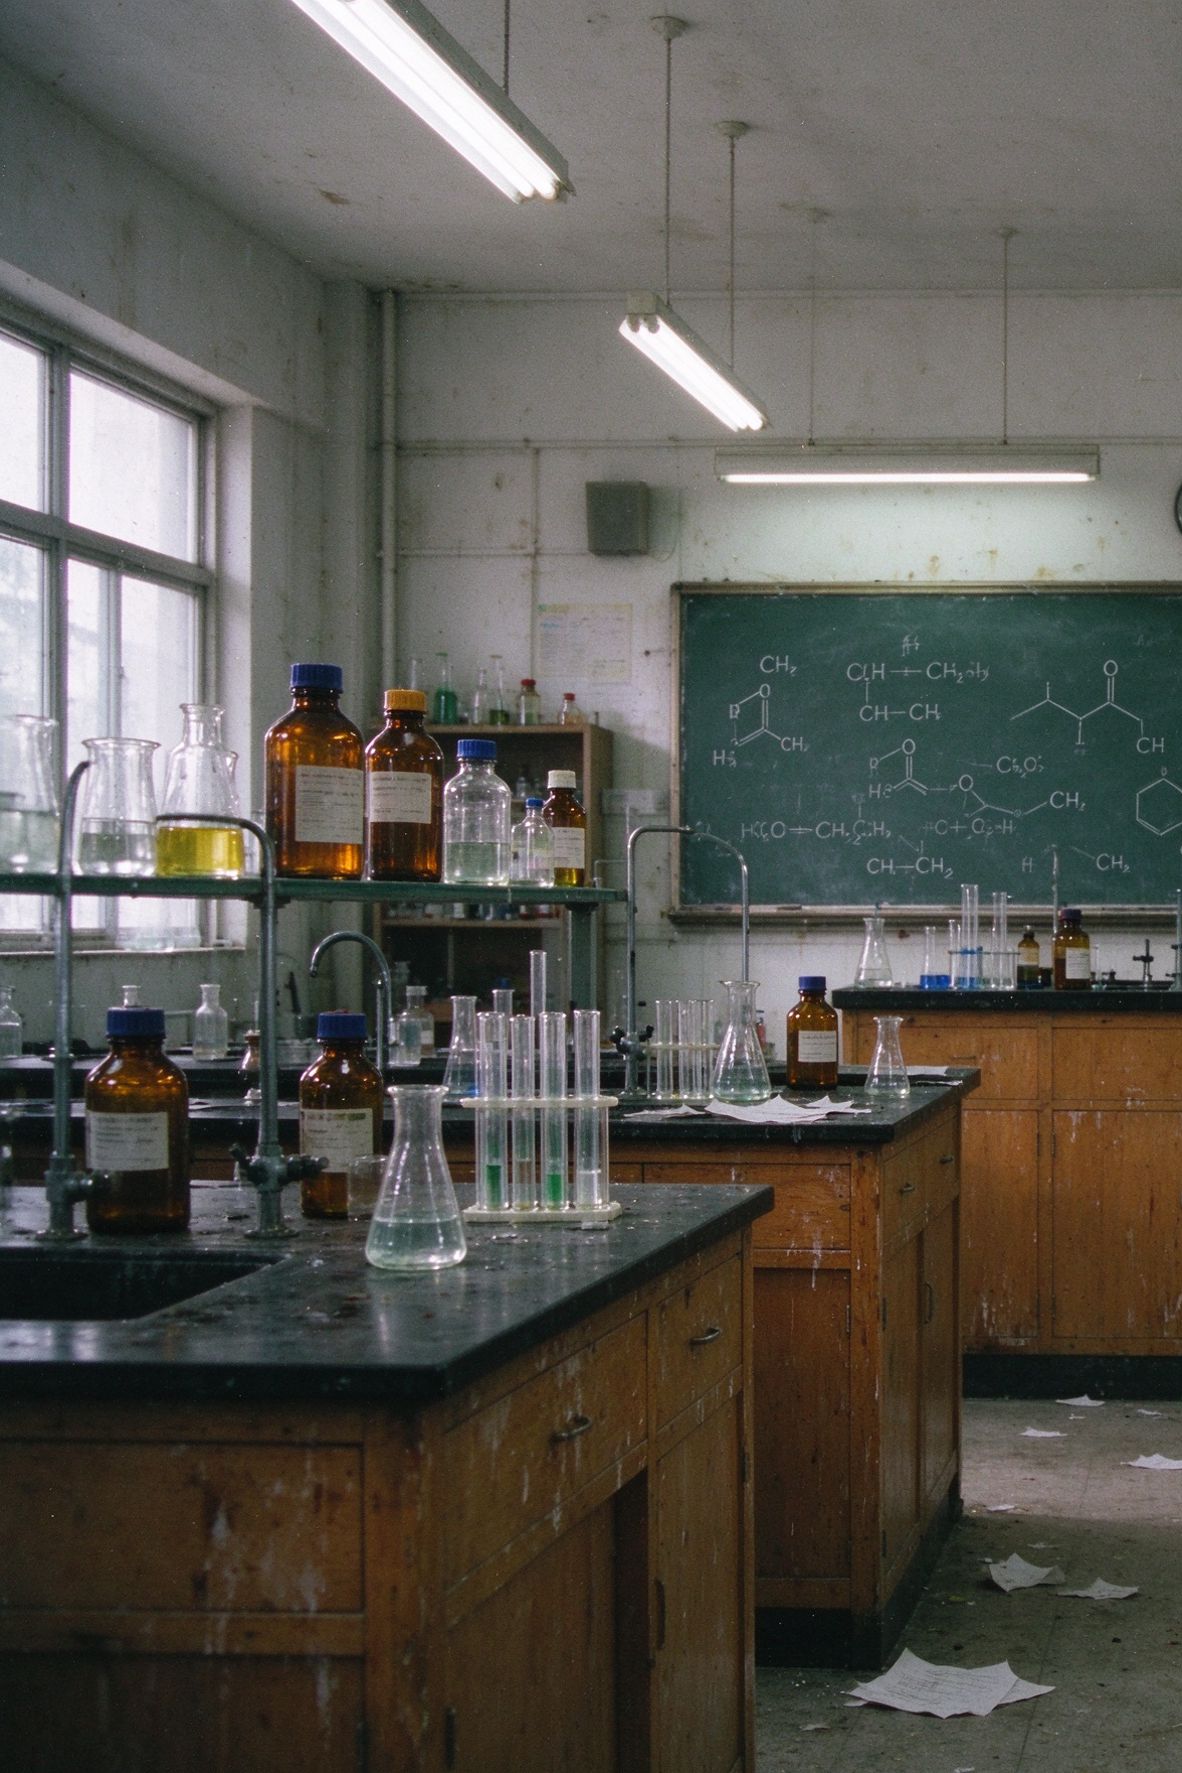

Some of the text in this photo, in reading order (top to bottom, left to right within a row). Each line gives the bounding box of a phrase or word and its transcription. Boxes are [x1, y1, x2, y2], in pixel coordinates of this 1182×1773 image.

[1104, 659, 1119, 677] O
[759, 683, 771, 698] O
[901, 738, 916, 755] O
[1136, 736, 1165, 754] CH
[958, 774, 974, 792] O
[915, 856, 954, 880] CH2
